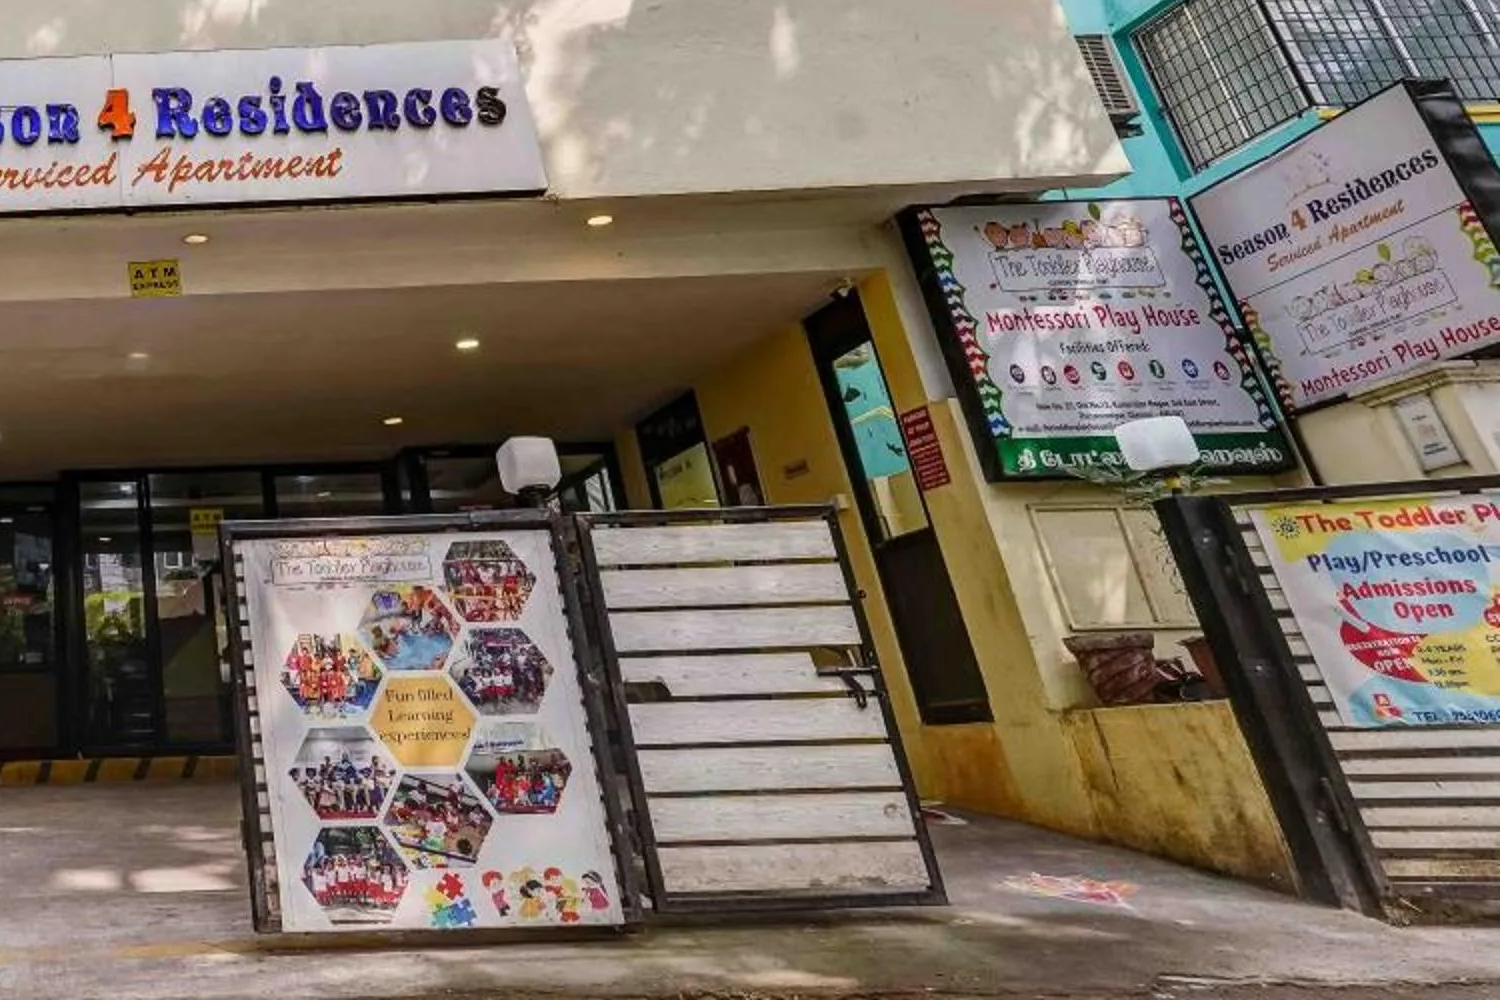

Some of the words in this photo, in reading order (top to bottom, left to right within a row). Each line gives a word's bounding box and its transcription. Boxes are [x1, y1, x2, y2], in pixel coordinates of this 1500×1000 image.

[98, 87, 138, 141] 4
[152, 75, 507, 139] Residences
[132, 146, 344, 192] Apartment
[1218, 223, 1290, 265] Season
[1289, 208, 1308, 231] 4
[1306, 149, 1439, 224] Residences
[1266, 234, 1322, 273] Serviced
[1327, 200, 1405, 244] Apartment
[986, 306, 1090, 333] Montessori
[1092, 304, 1142, 335] Play
[1142, 303, 1200, 328] House
[1301, 351, 1391, 397] Montessori
[1392, 338, 1439, 368] Play
[1439, 316, 1500, 349] House
[1296, 513, 1352, 533] The
[1355, 506, 1467, 530] Toddler
[1306, 544, 1491, 574] Play/Preschool
[1342, 577, 1477, 600] Admissions
[1394, 601, 1454, 623] Open
[388, 708, 454, 724] Learning
